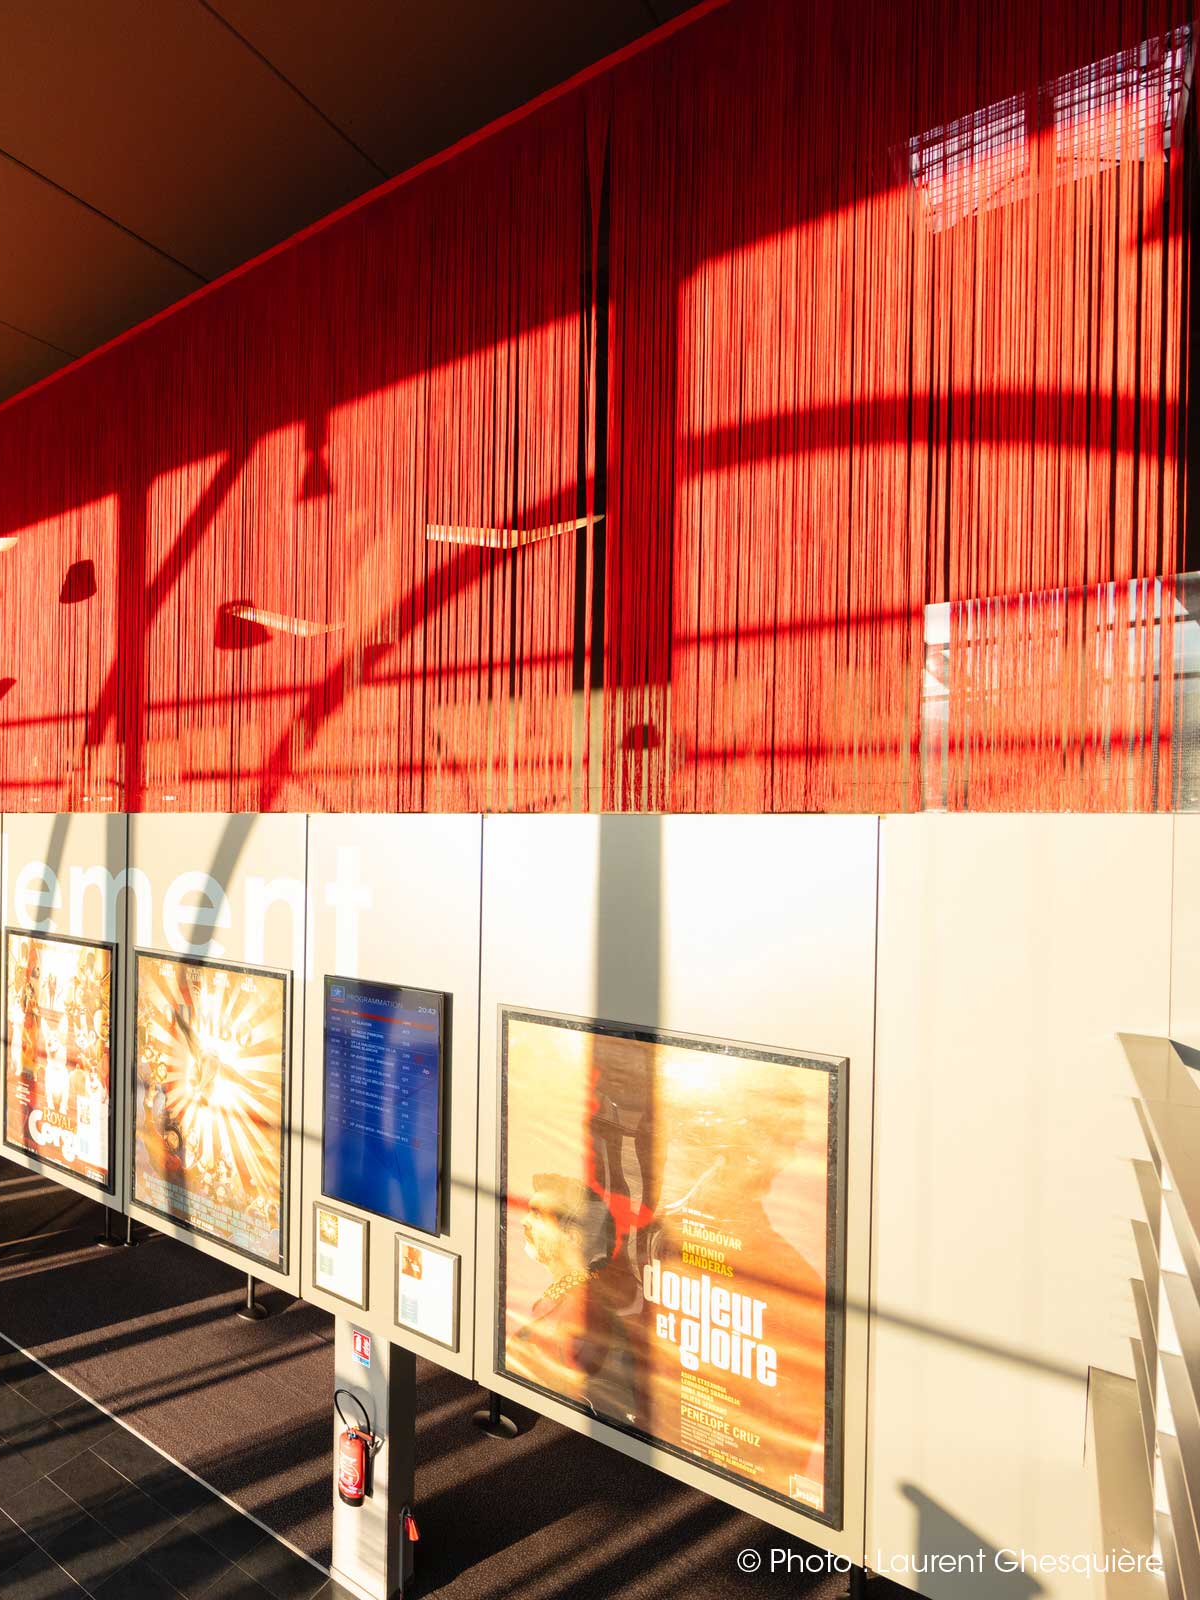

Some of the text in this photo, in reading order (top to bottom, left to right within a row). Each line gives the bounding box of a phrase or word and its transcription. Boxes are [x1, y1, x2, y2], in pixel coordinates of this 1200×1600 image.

[346, 994, 403, 1009] PROGRAMMATION
[43, 1107, 73, 1131] ROYAL
[682, 1223, 742, 1251] ALMODÓVAR
[682, 1242, 725, 1263] ANTONIO
[682, 1252, 734, 1278] BANDERAS
[643, 1259, 767, 1340] douleur
[656, 1312, 777, 1388] et gloire
[732, 1426, 761, 1447] CRUZ
